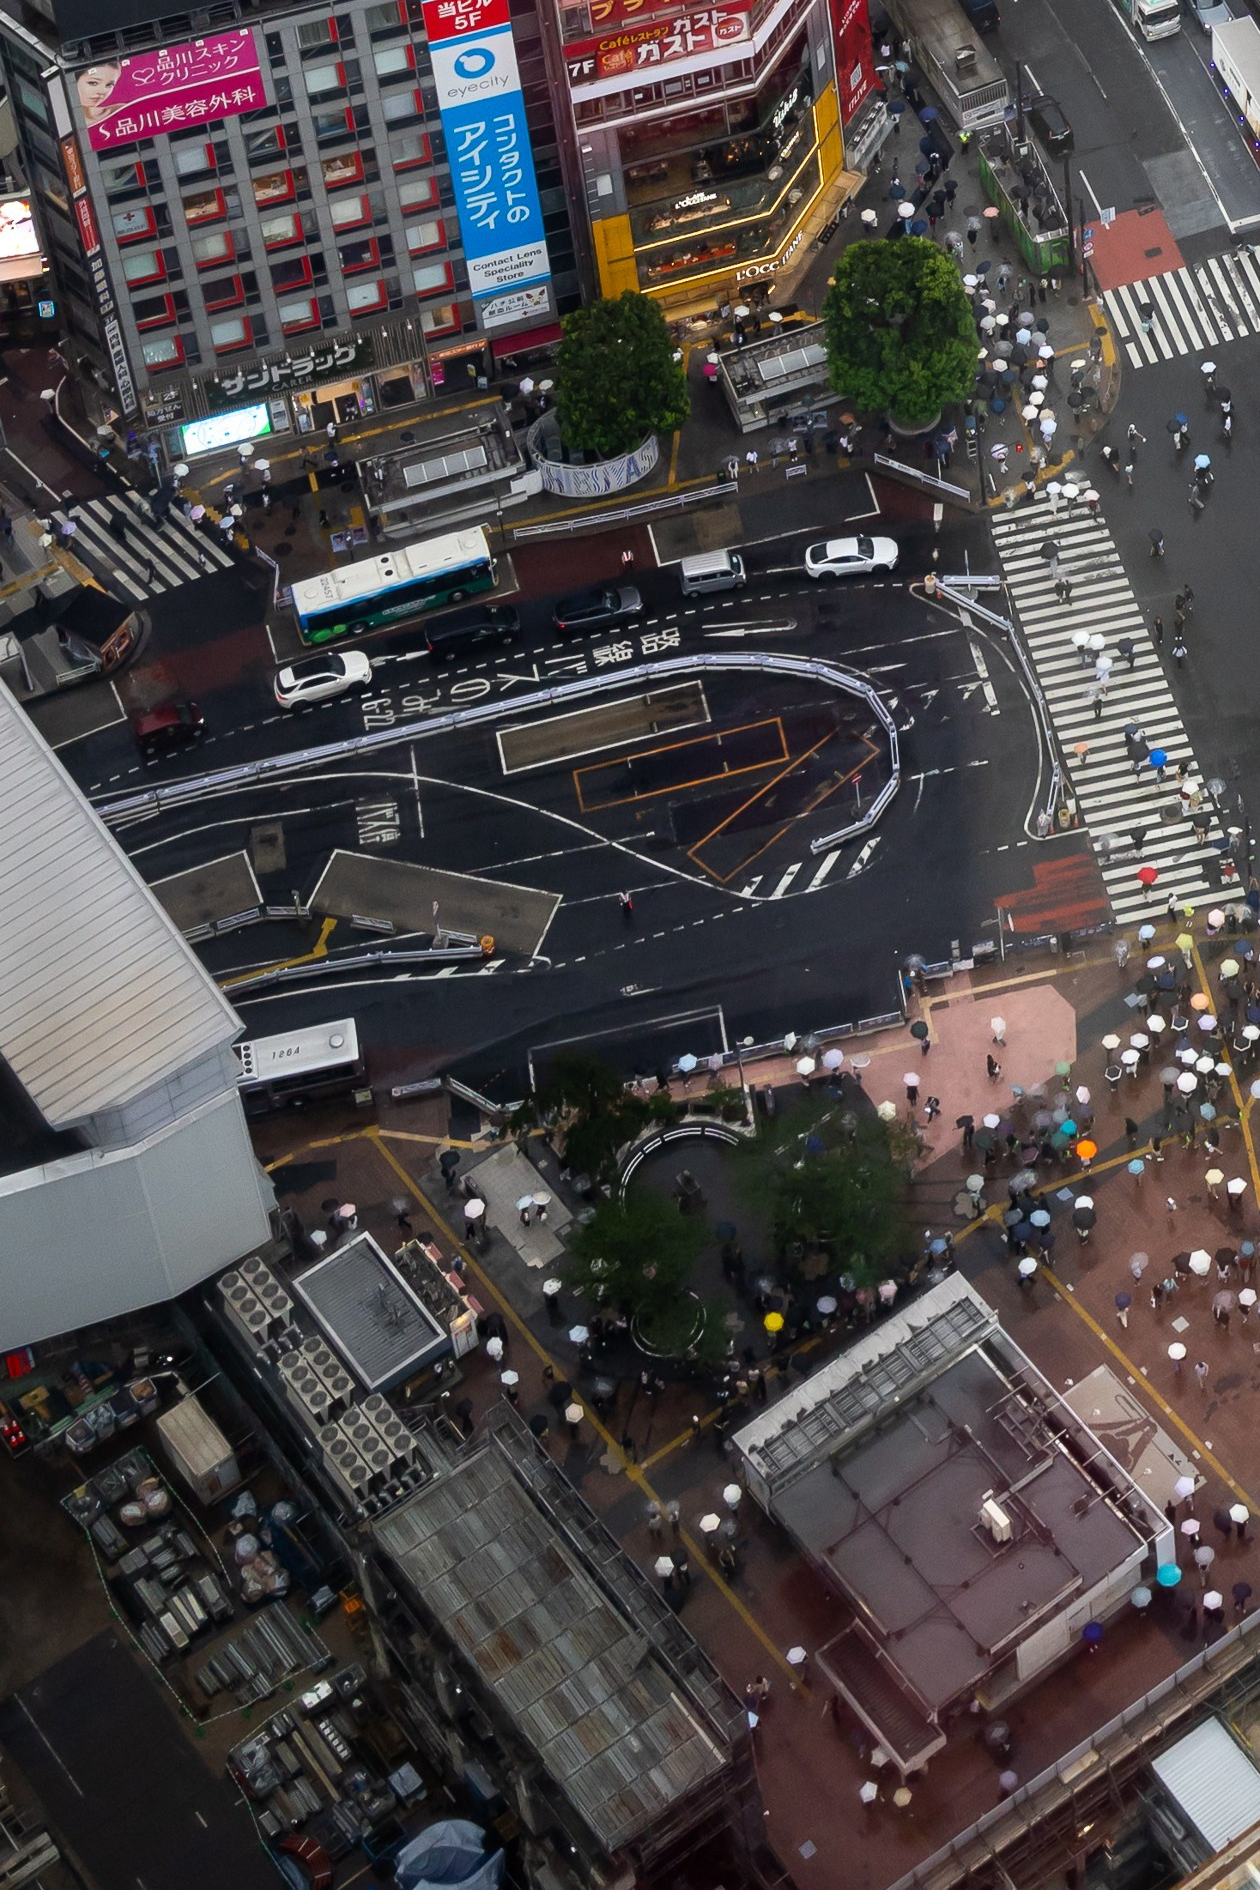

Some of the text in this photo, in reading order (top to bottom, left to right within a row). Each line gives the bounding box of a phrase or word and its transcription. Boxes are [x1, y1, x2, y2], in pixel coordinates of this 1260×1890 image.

[454, 11, 483, 30] 5F
[673, 10, 728, 35] ガスト
[156, 37, 246, 72] 品川スキン
[637, 32, 706, 65] ガスト
[160, 55, 239, 86] クリニック
[568, 59, 595, 78] 7F
[447, 73, 510, 100] eyecity
[115, 84, 257, 138] 品川美容外科
[453, 119, 500, 230] アイシティ
[493, 112, 531, 224] コンタクトの
[473, 248, 543, 273] Contact Lens
[483, 260, 536, 279] Speciality
[495, 270, 525, 283] Store
[221, 344, 357, 396] サンドラッグ
